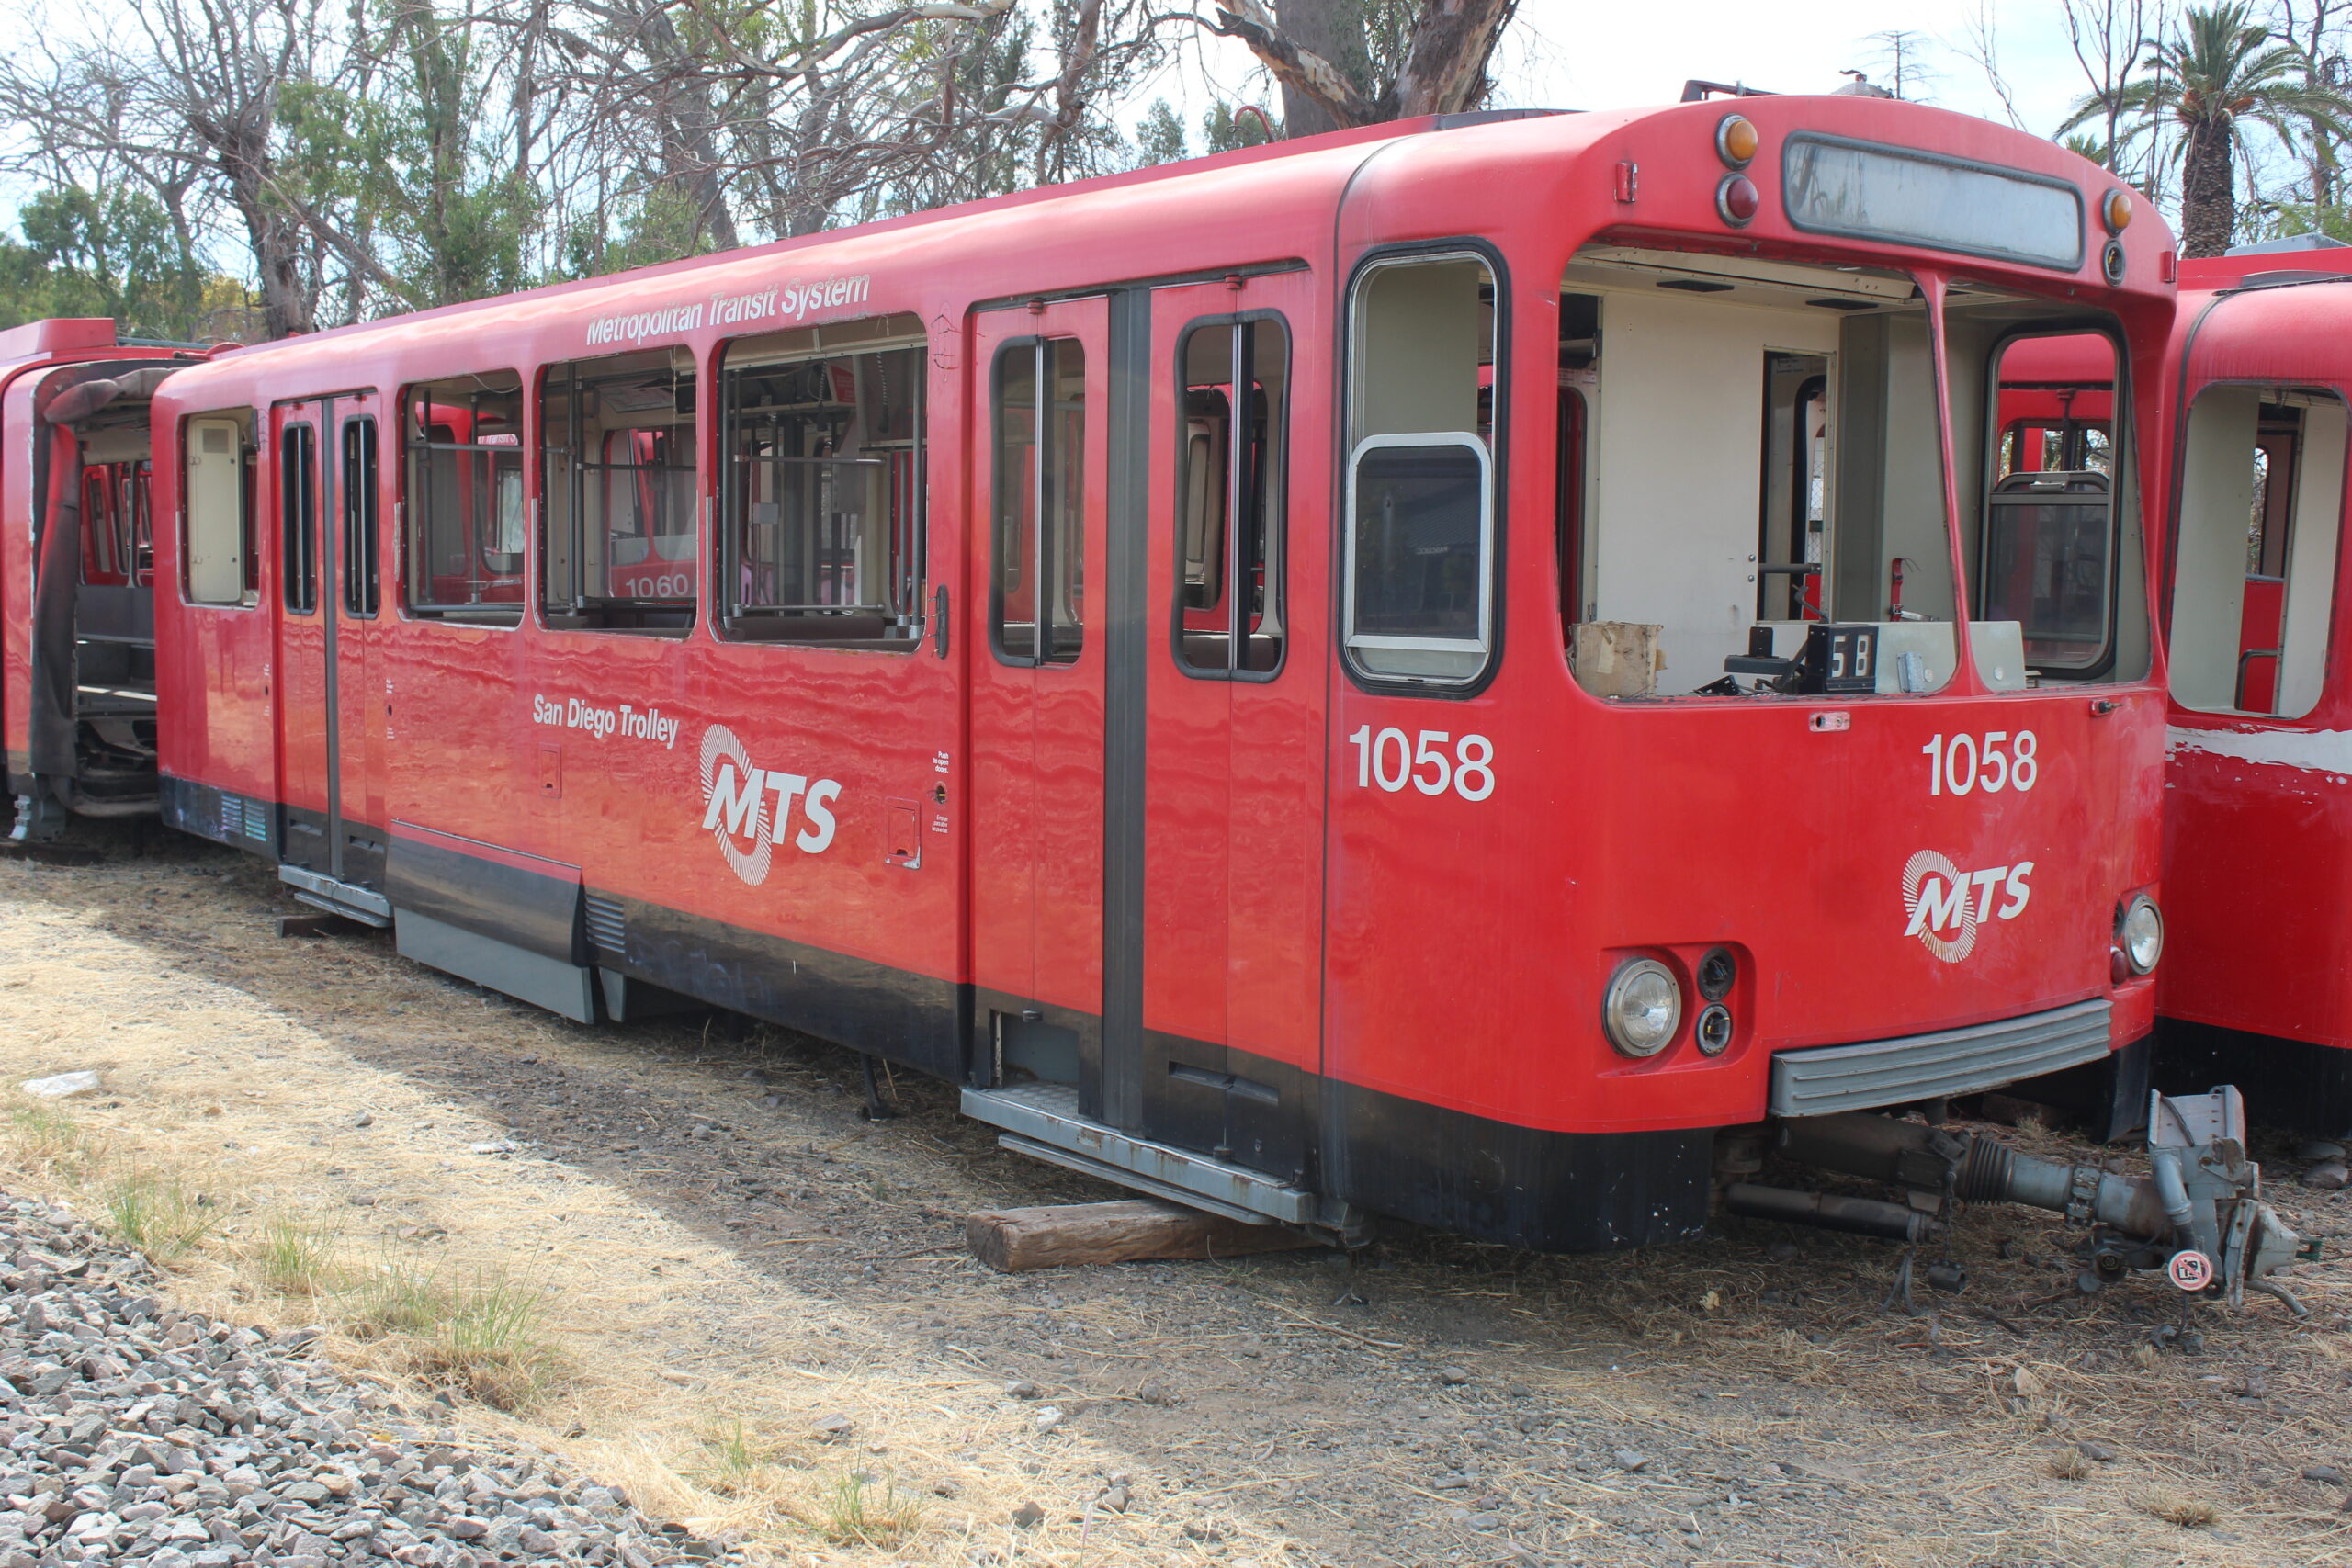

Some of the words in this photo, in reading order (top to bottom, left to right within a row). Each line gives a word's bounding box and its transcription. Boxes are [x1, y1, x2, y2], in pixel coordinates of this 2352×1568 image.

[586, 301, 703, 345] Metropolitan
[709, 282, 779, 325] Transit
[781, 274, 870, 321] System
[626, 574, 689, 598] 1060
[1832, 635, 1869, 678] 58
[533, 694, 562, 726] San
[567, 698, 616, 739] Diego
[619, 705, 679, 749] Trolley
[938, 750, 949, 759] Push
[1349, 724, 1496, 802] 1058
[1922, 729, 2038, 796] 1058
[702, 764, 842, 853] MTS
[1904, 861, 2034, 937] MTS
